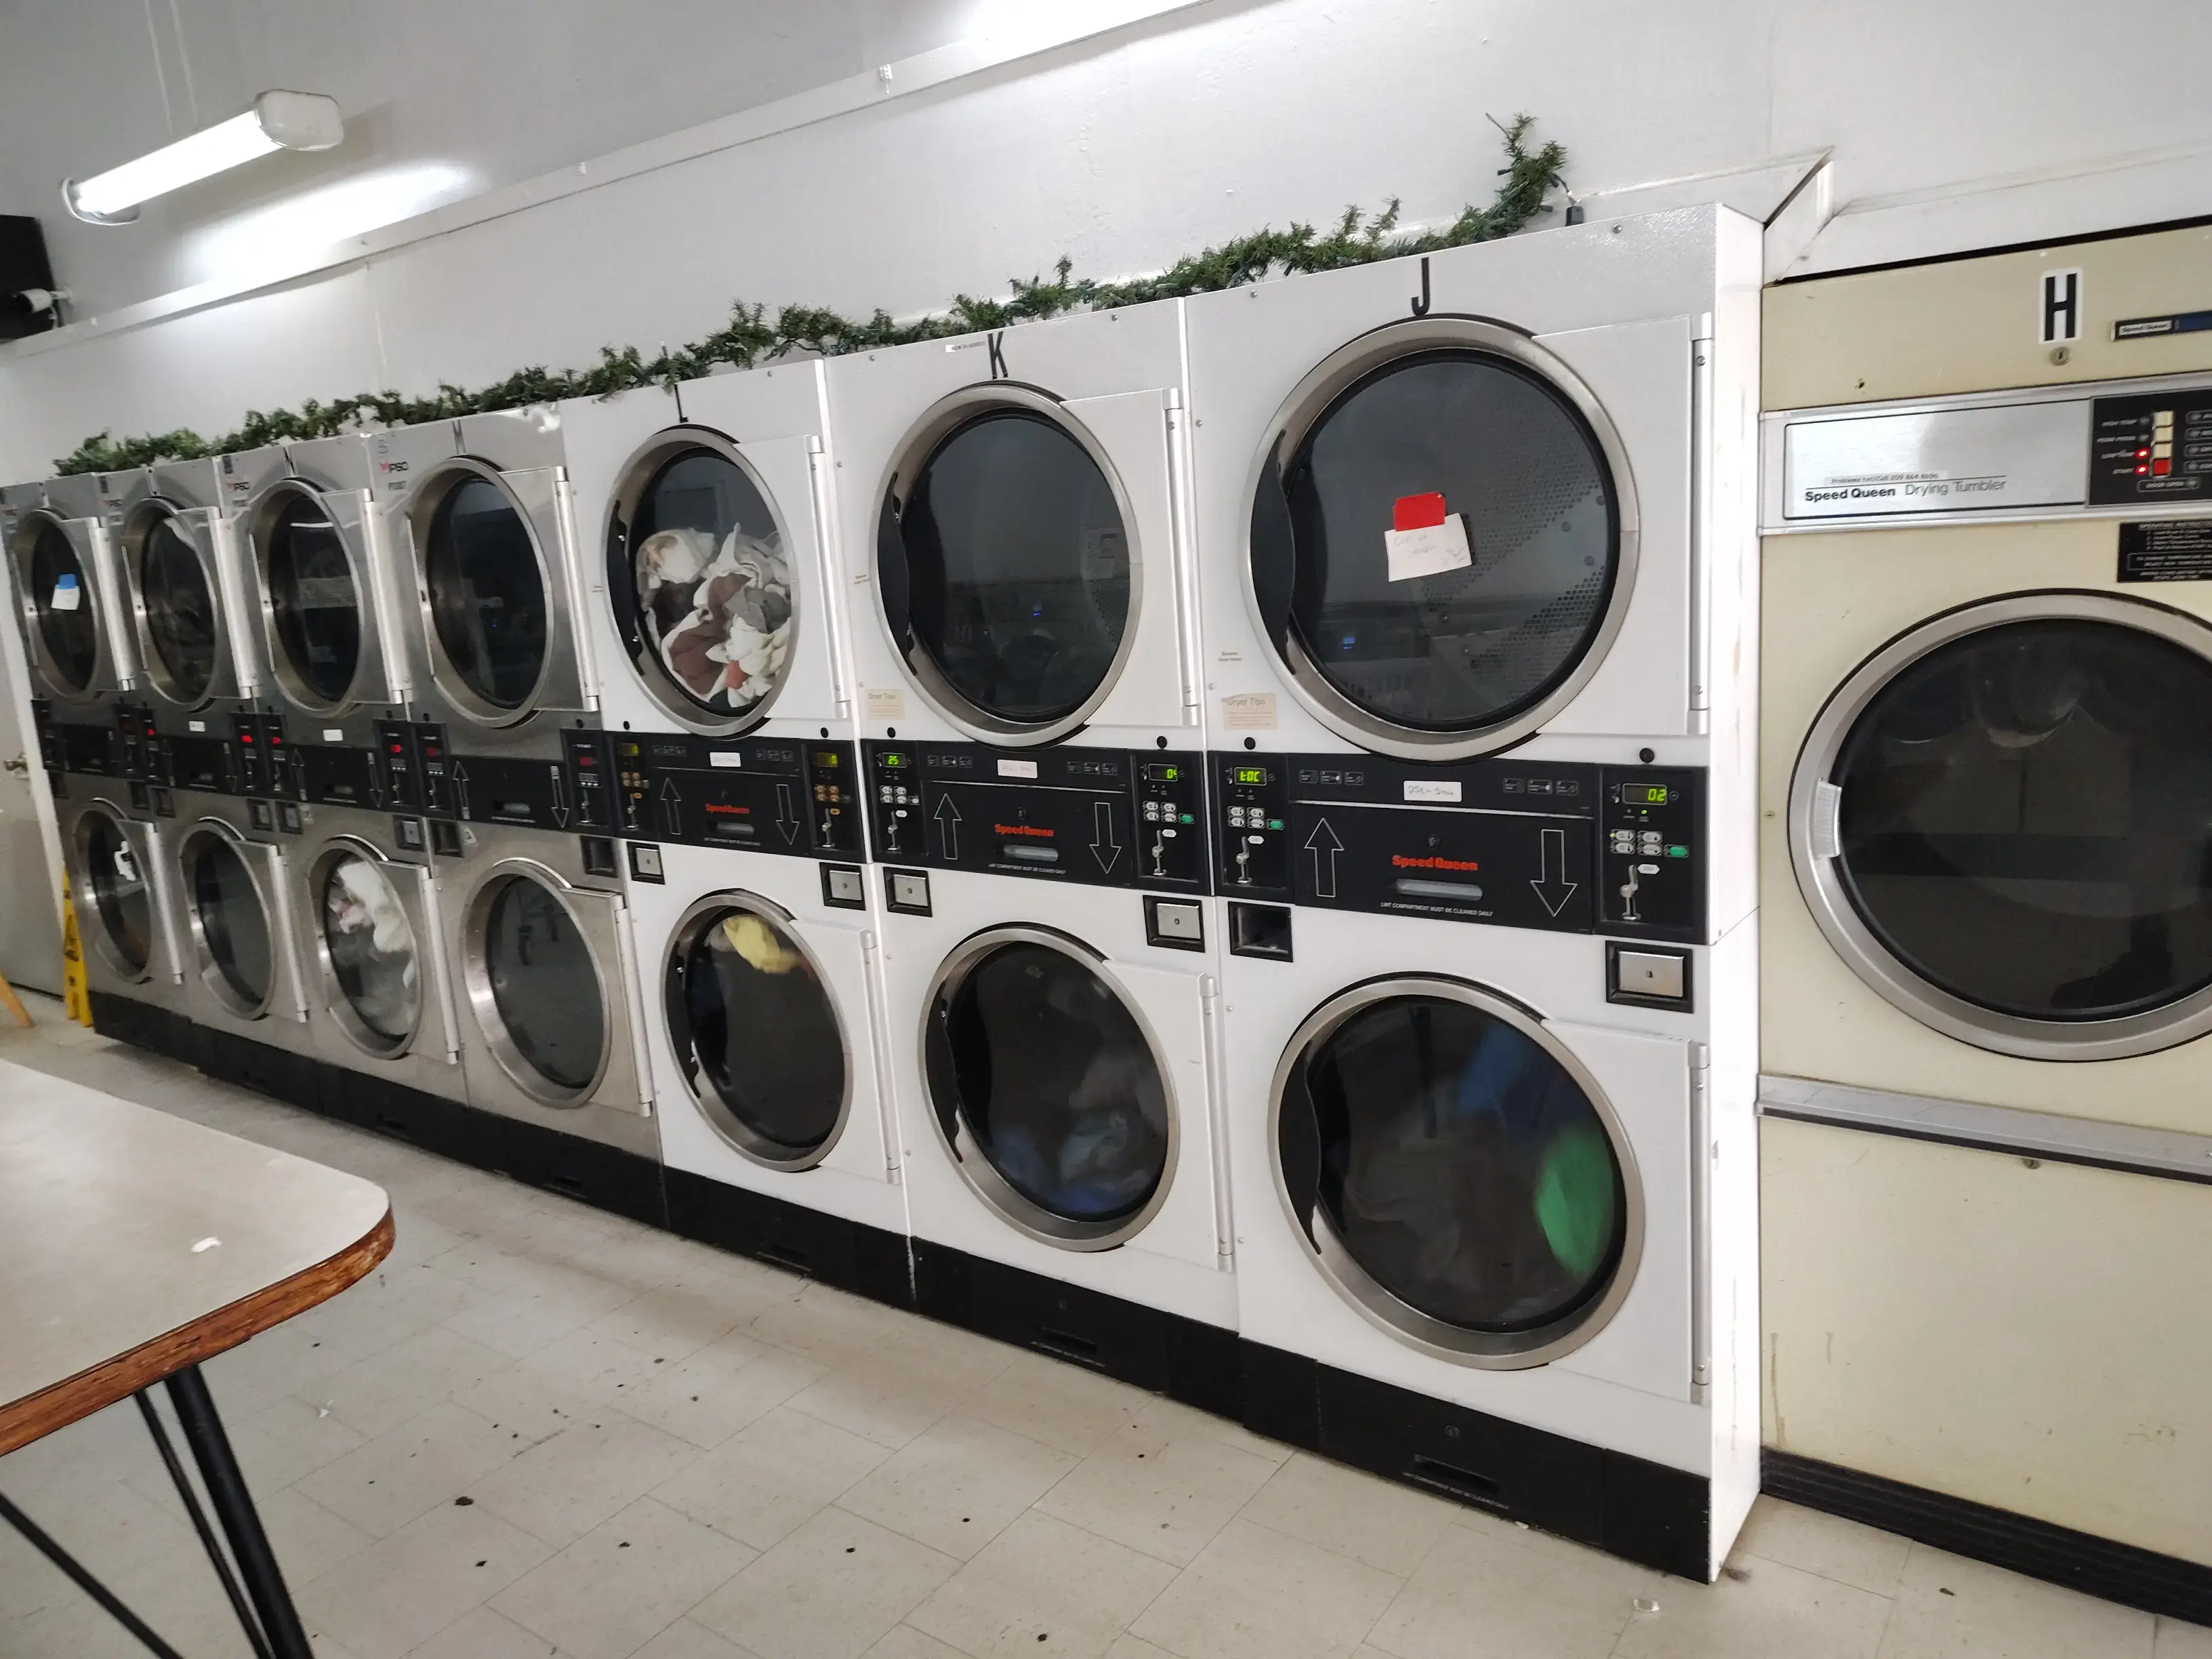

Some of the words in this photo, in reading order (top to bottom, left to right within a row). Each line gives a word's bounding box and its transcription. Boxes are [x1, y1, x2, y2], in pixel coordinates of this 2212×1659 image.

[1411, 257, 1431, 316] J
[2044, 273, 2077, 342] H
[987, 331, 1008, 380] K
[1805, 488, 1848, 503] Speed
[1851, 487, 1896, 499] Queen
[1904, 483, 1948, 497] Drying
[1952, 479, 2007, 493] Tumbler
[1647, 788, 1667, 801] 02
[994, 823, 1023, 835] Speed
[1392, 855, 1433, 868] Speed
[1435, 857, 1478, 872] Queen
